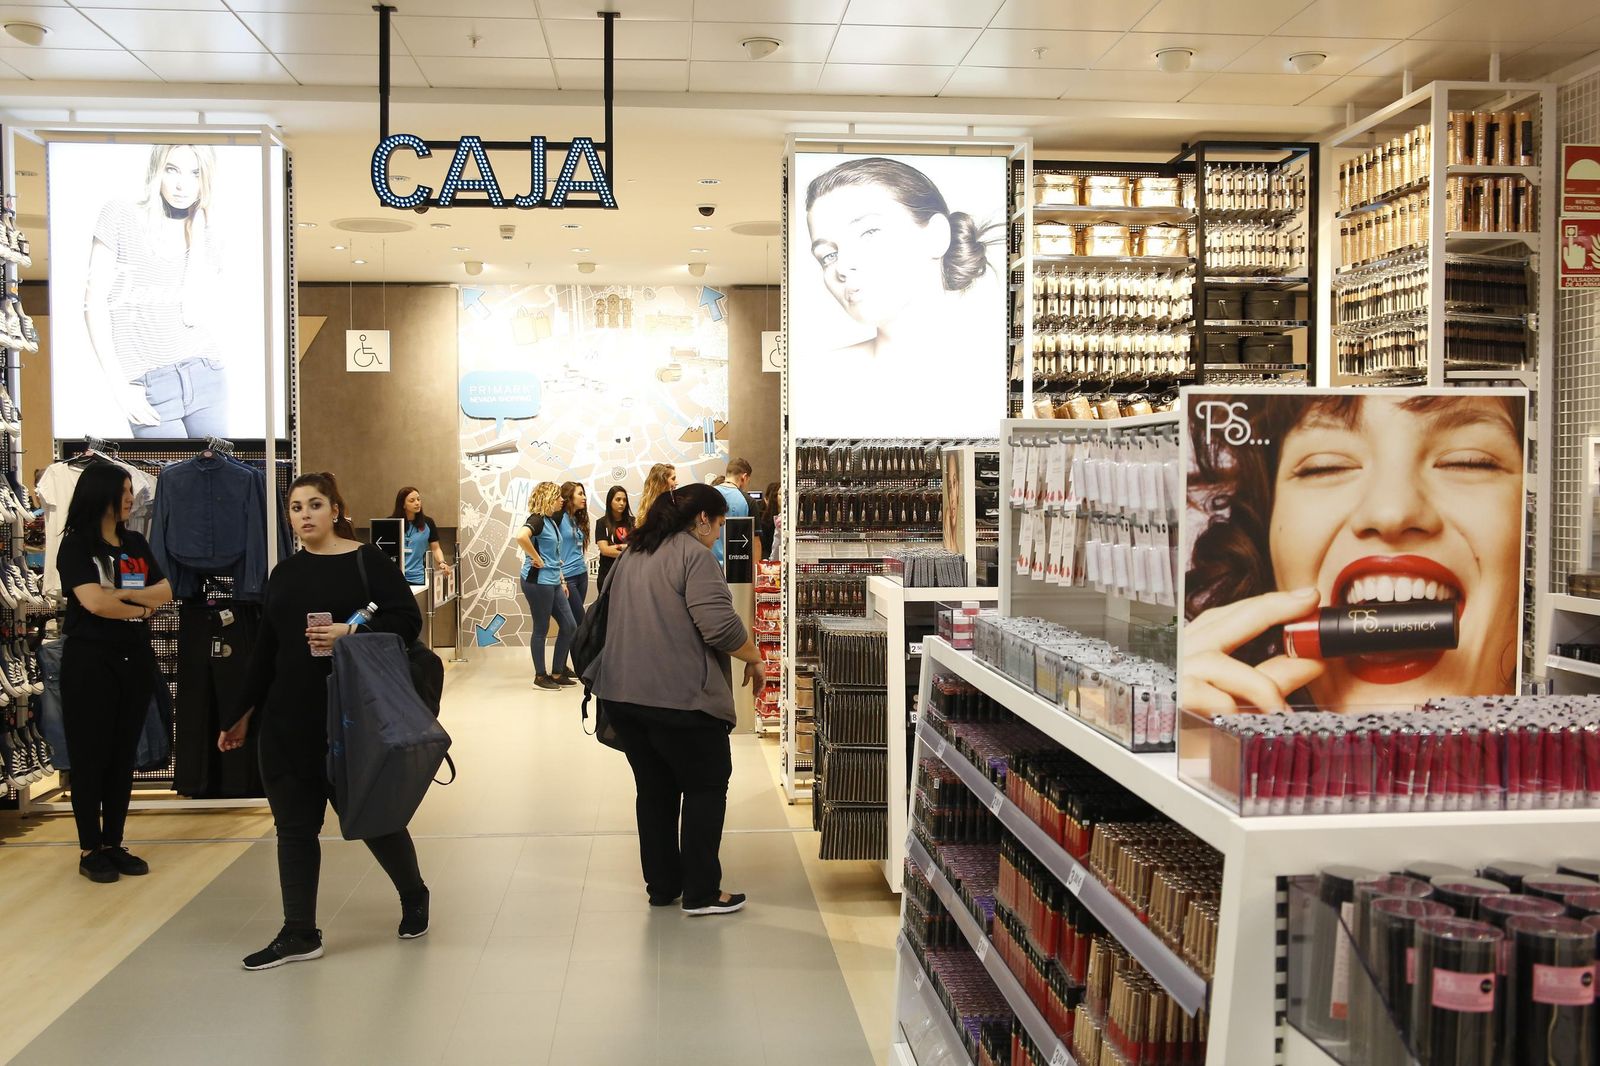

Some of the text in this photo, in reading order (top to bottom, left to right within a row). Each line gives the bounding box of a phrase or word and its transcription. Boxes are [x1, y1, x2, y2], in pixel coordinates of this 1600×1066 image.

[371, 133, 619, 210] CAJA
[469, 384, 531, 394] PRIMARK
[1393, 621, 1436, 633] LIPSTICK
